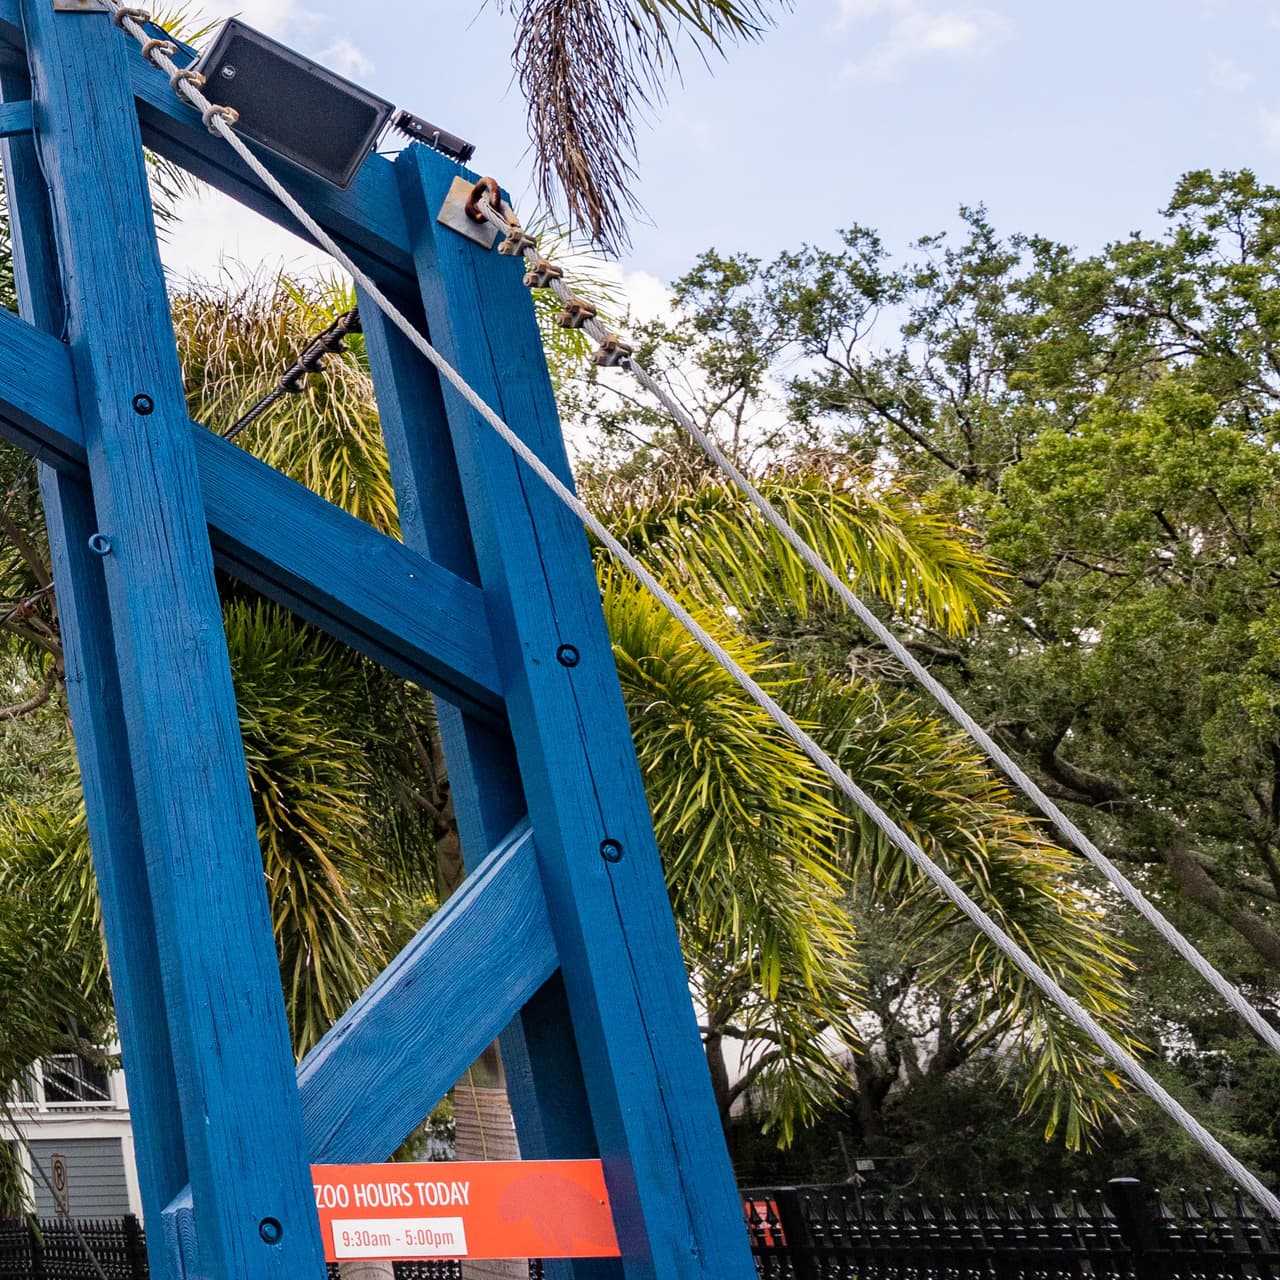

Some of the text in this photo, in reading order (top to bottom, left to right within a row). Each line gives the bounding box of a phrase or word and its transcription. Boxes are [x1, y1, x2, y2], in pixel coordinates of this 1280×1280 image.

[313, 1181, 471, 1209] ZOO HOURS TODAY
[342, 1229, 392, 1248] 9:30am
[404, 1228, 455, 1249] 5:00pm
